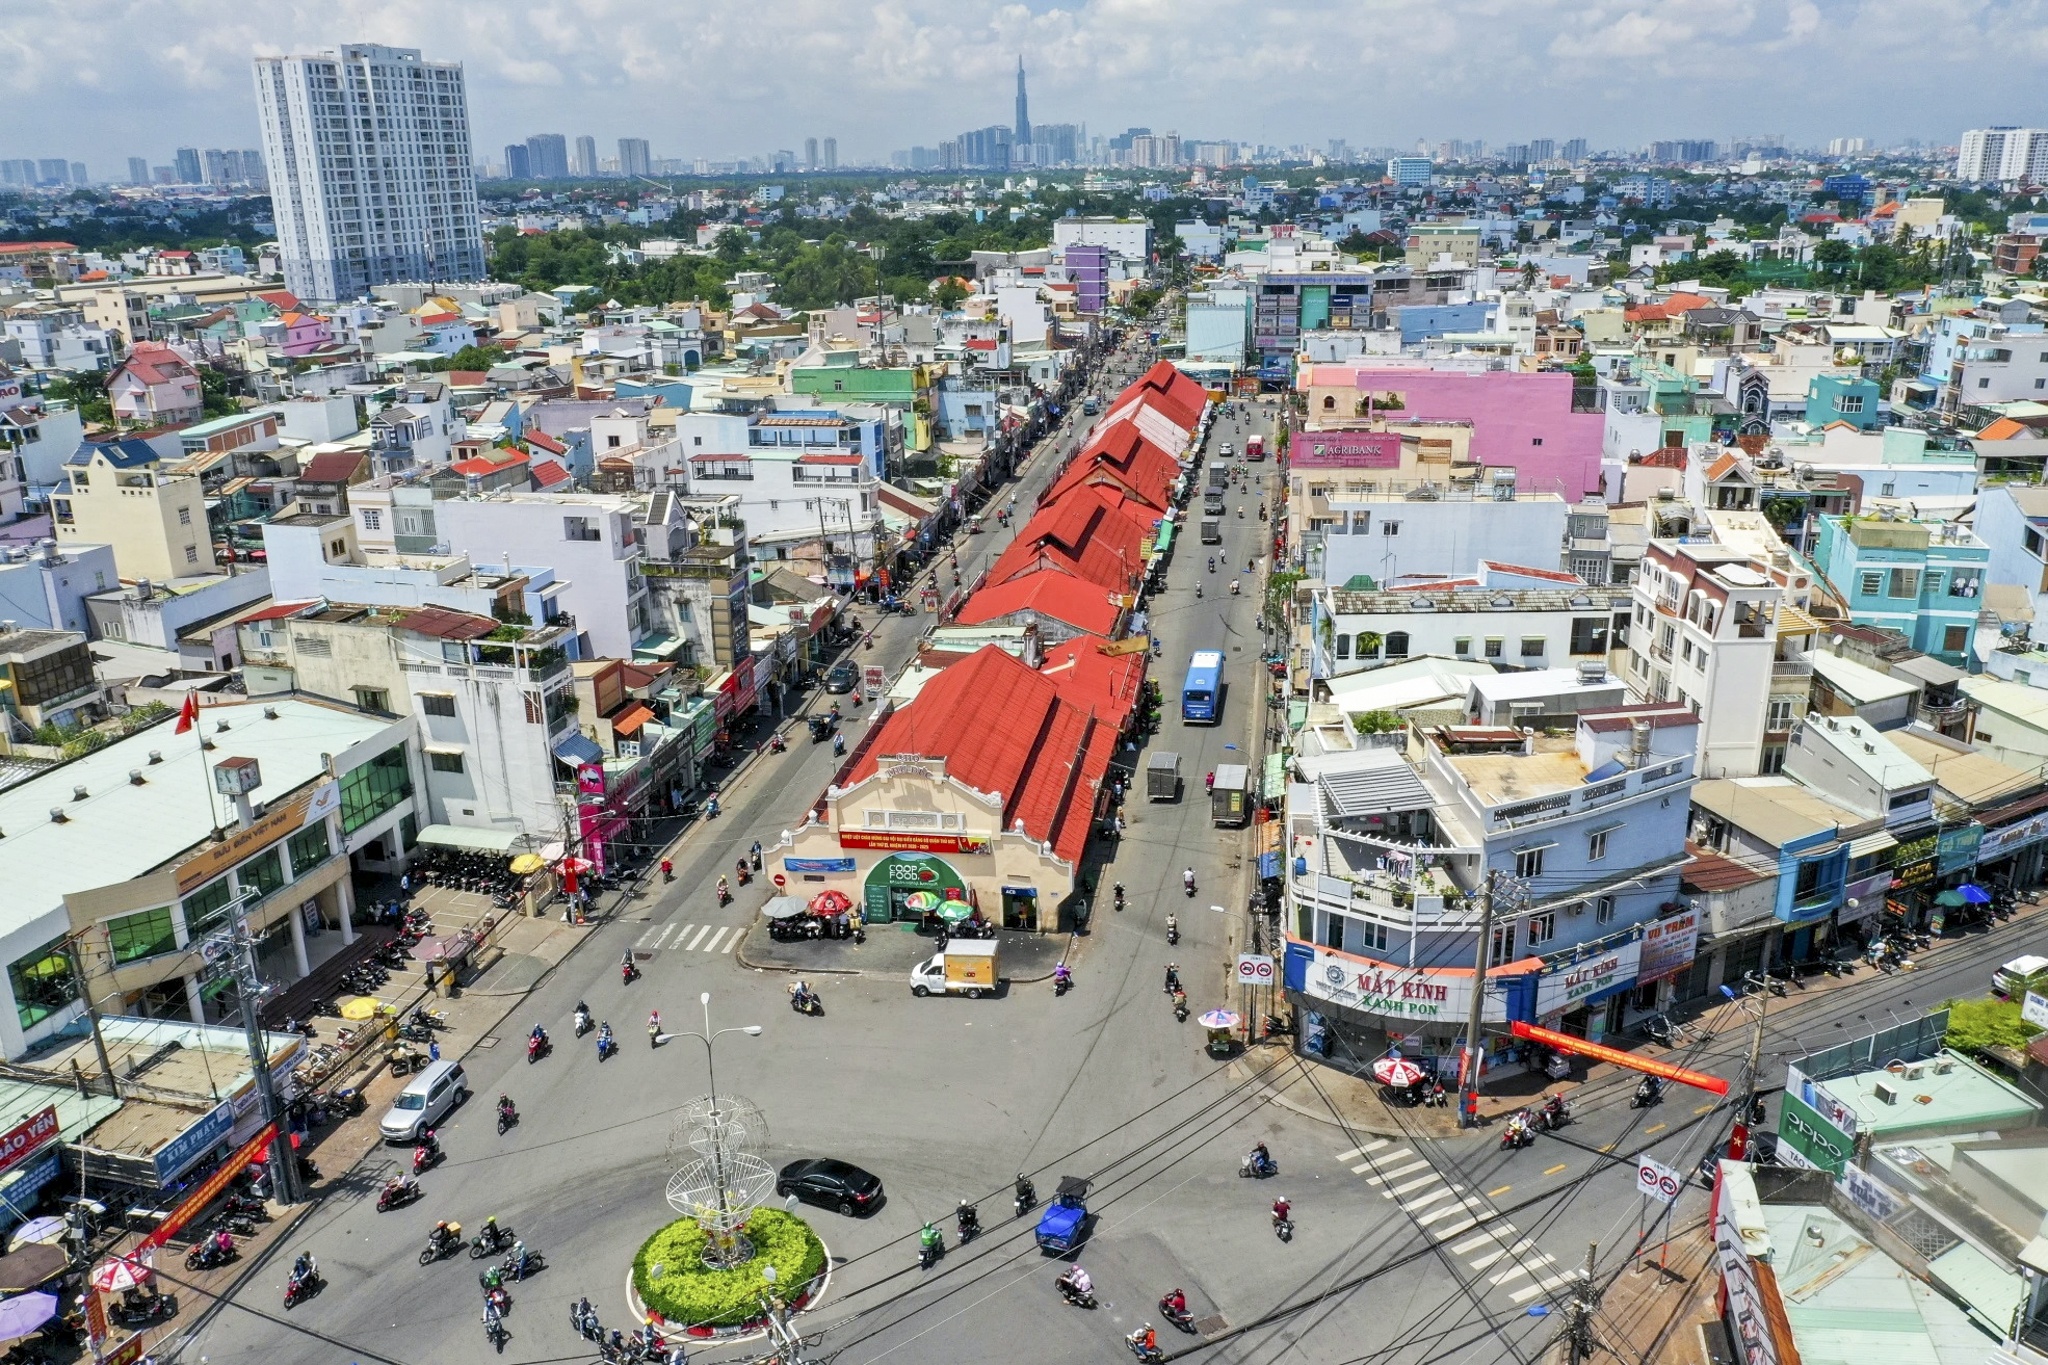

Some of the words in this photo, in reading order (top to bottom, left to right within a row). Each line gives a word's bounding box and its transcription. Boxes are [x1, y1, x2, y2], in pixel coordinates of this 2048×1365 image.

[1327, 445, 1381, 455] AGRIBANK
[889, 864, 917, 872] COOP
[1357, 970, 1395, 997] MẮT
[1401, 974, 1448, 1001] KÍNH
[1362, 995, 1404, 1013] XANH
[1409, 1002, 1439, 1016] PON
